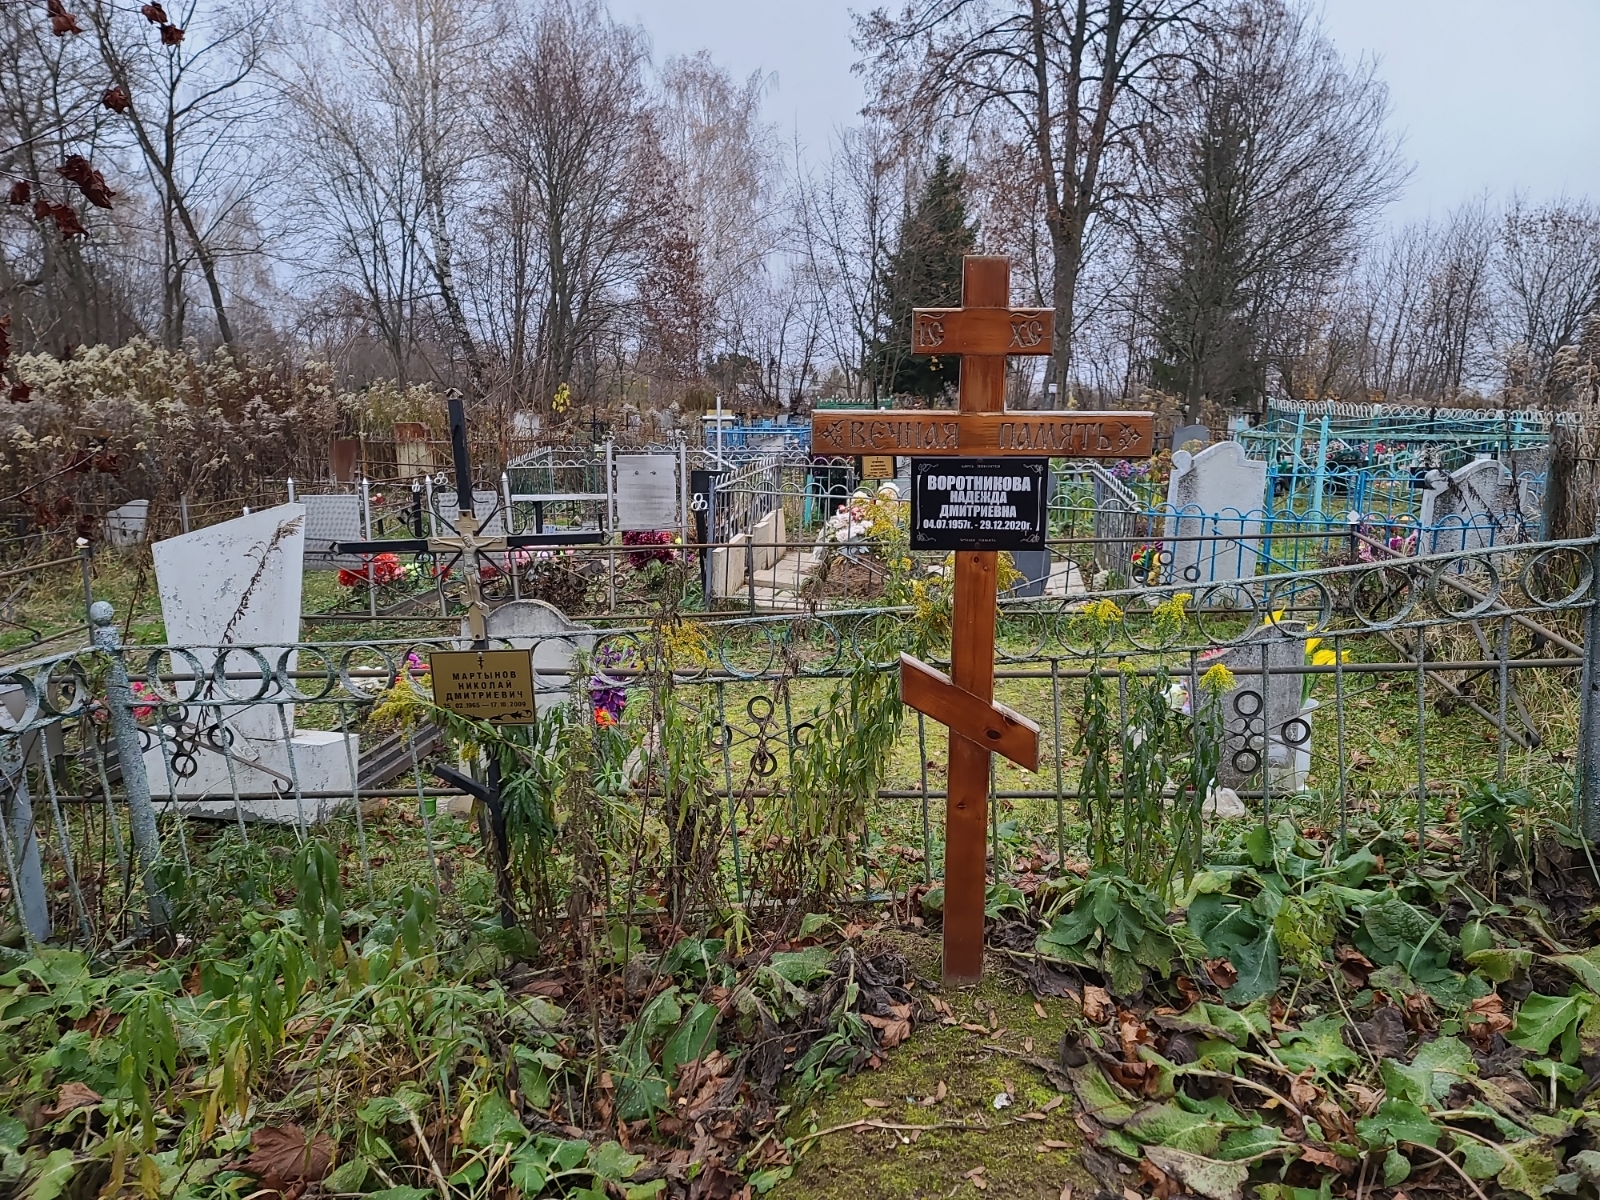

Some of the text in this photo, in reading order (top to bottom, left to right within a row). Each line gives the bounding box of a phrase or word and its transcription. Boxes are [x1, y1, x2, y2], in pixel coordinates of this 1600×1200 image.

[850, 420, 1113, 451] ВЕЧНАЯ ПАМЯТЬ
[927, 475, 1031, 492] ВОРОТНИКОВА
[949, 490, 1008, 505] НАДЕЖДА
[939, 504, 1017, 518] ДМИТРИЕВНА
[922, 519, 974, 530] 04.07.1957г.
[979, 520, 1033, 530] 29.12.2020г.
[452, 671, 517, 681] МАРТЫНОВ
[458, 680, 512, 690] НИКОЛАЙ
[446, 690, 523, 702] ДМИТРИЕВИЧ
